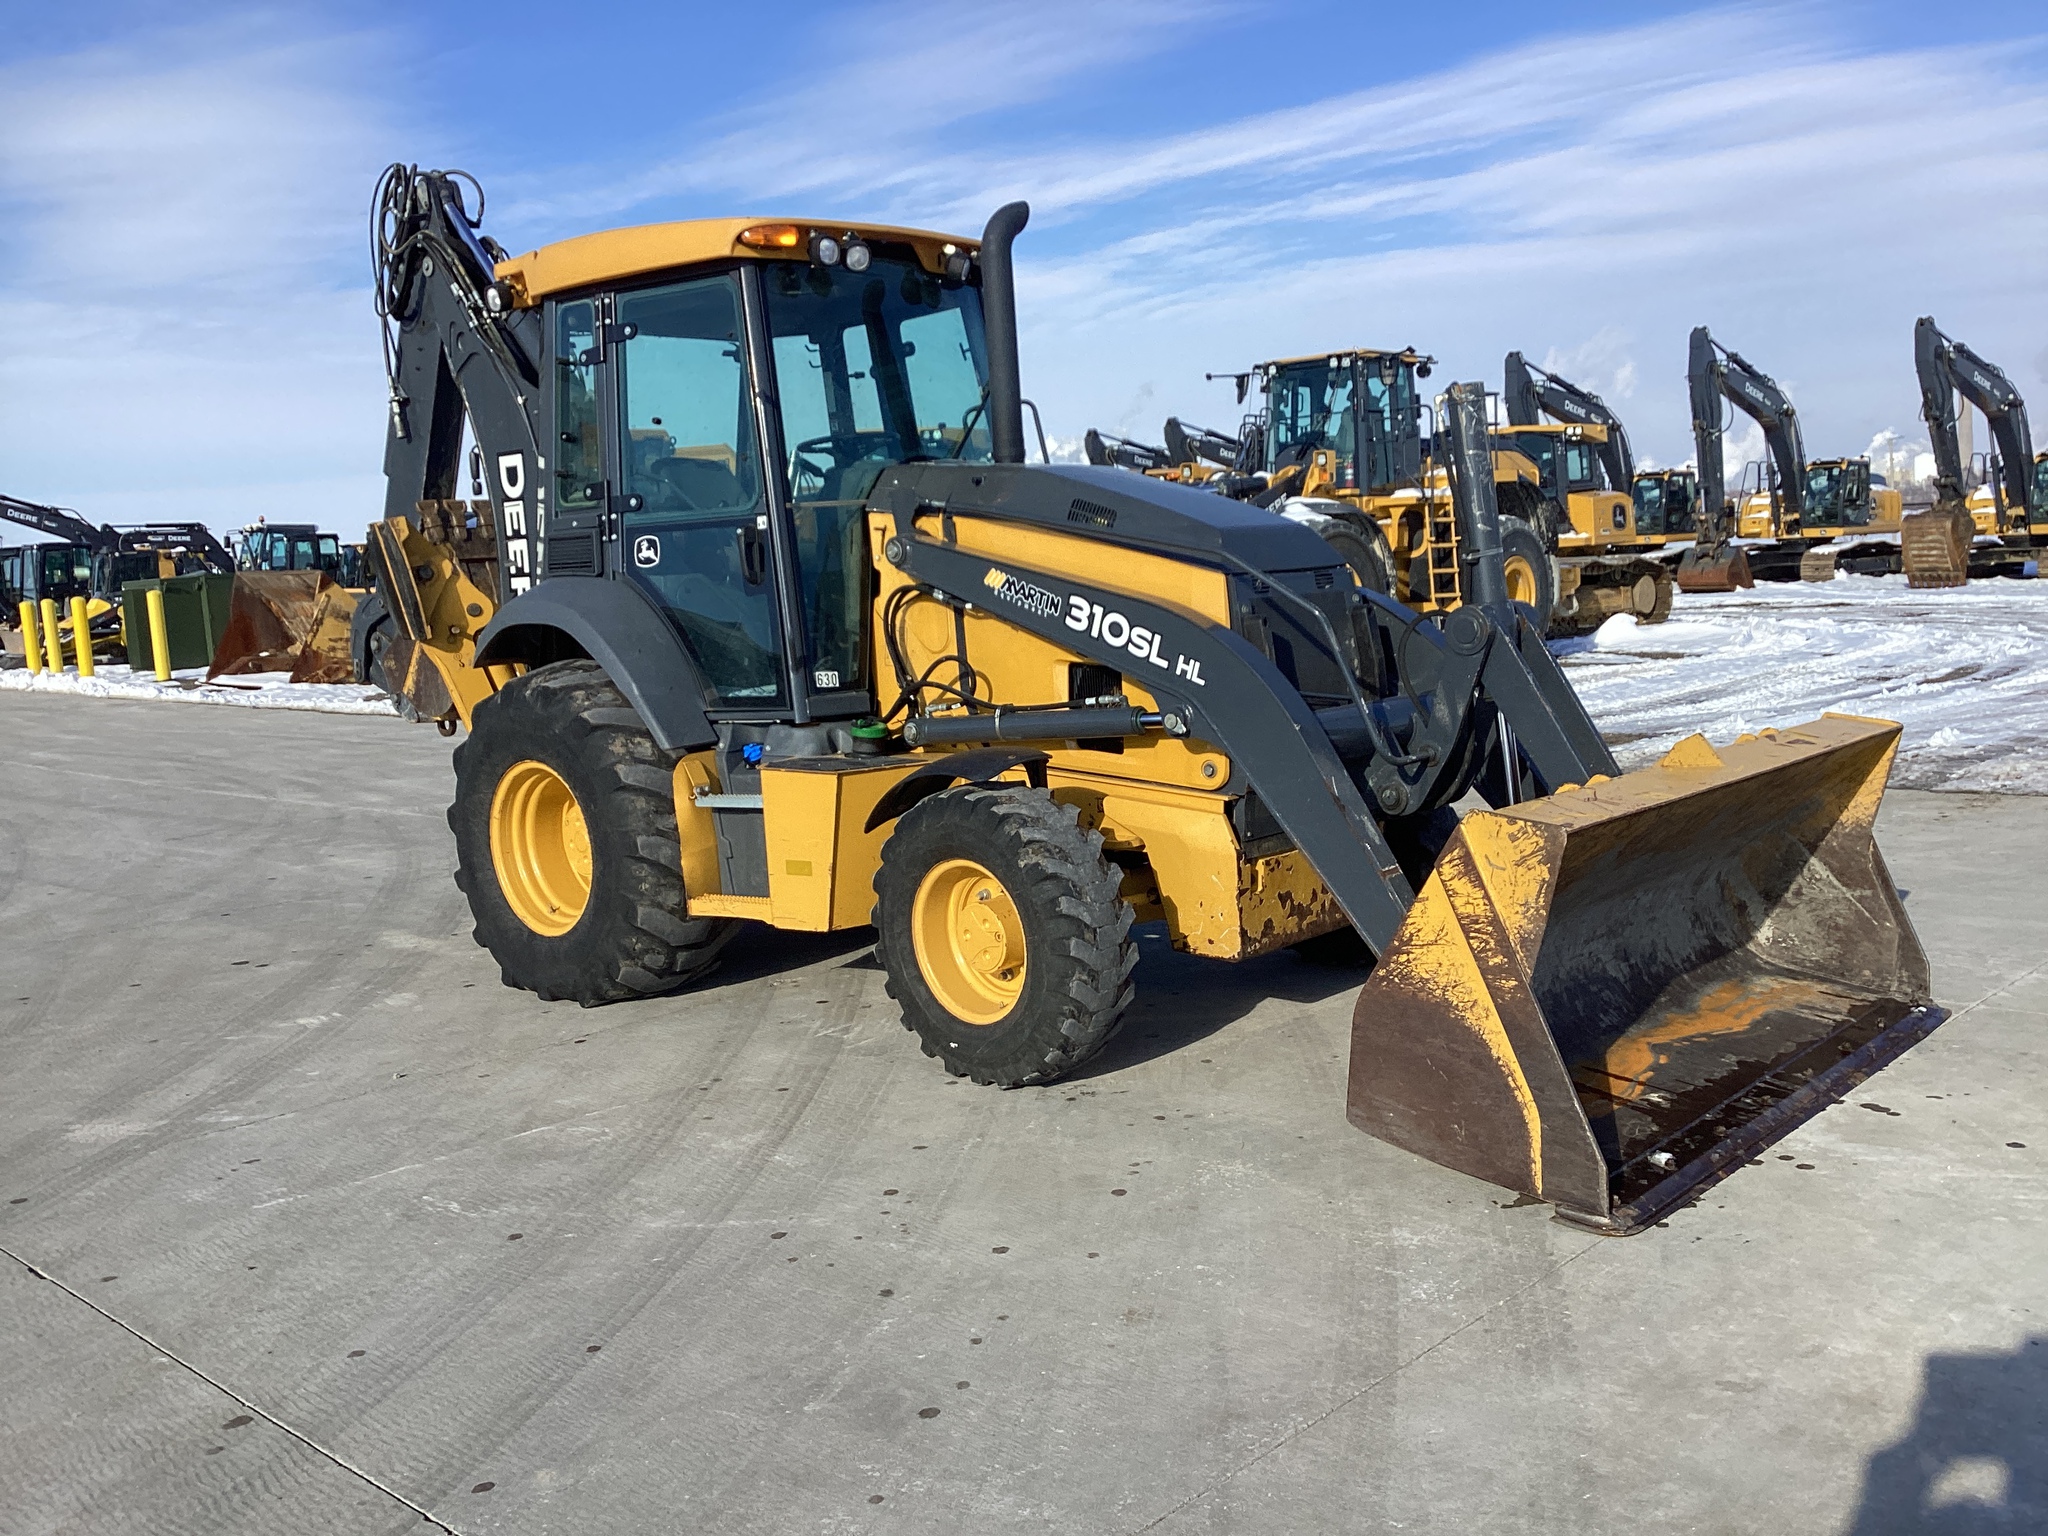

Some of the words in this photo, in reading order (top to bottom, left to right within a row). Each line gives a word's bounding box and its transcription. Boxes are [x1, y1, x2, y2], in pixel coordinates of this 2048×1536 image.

[1745, 381, 1765, 402] DEERE
[1564, 399, 1586, 419] DEERE
[7, 508, 38, 523] DEERE
[993, 590, 1048, 618] EQUIPMENT
[1000, 574, 1062, 617] MARTIN
[1065, 595, 1169, 669] 310SL
[1175, 654, 1207, 686] HL
[816, 672, 838, 687] 630
